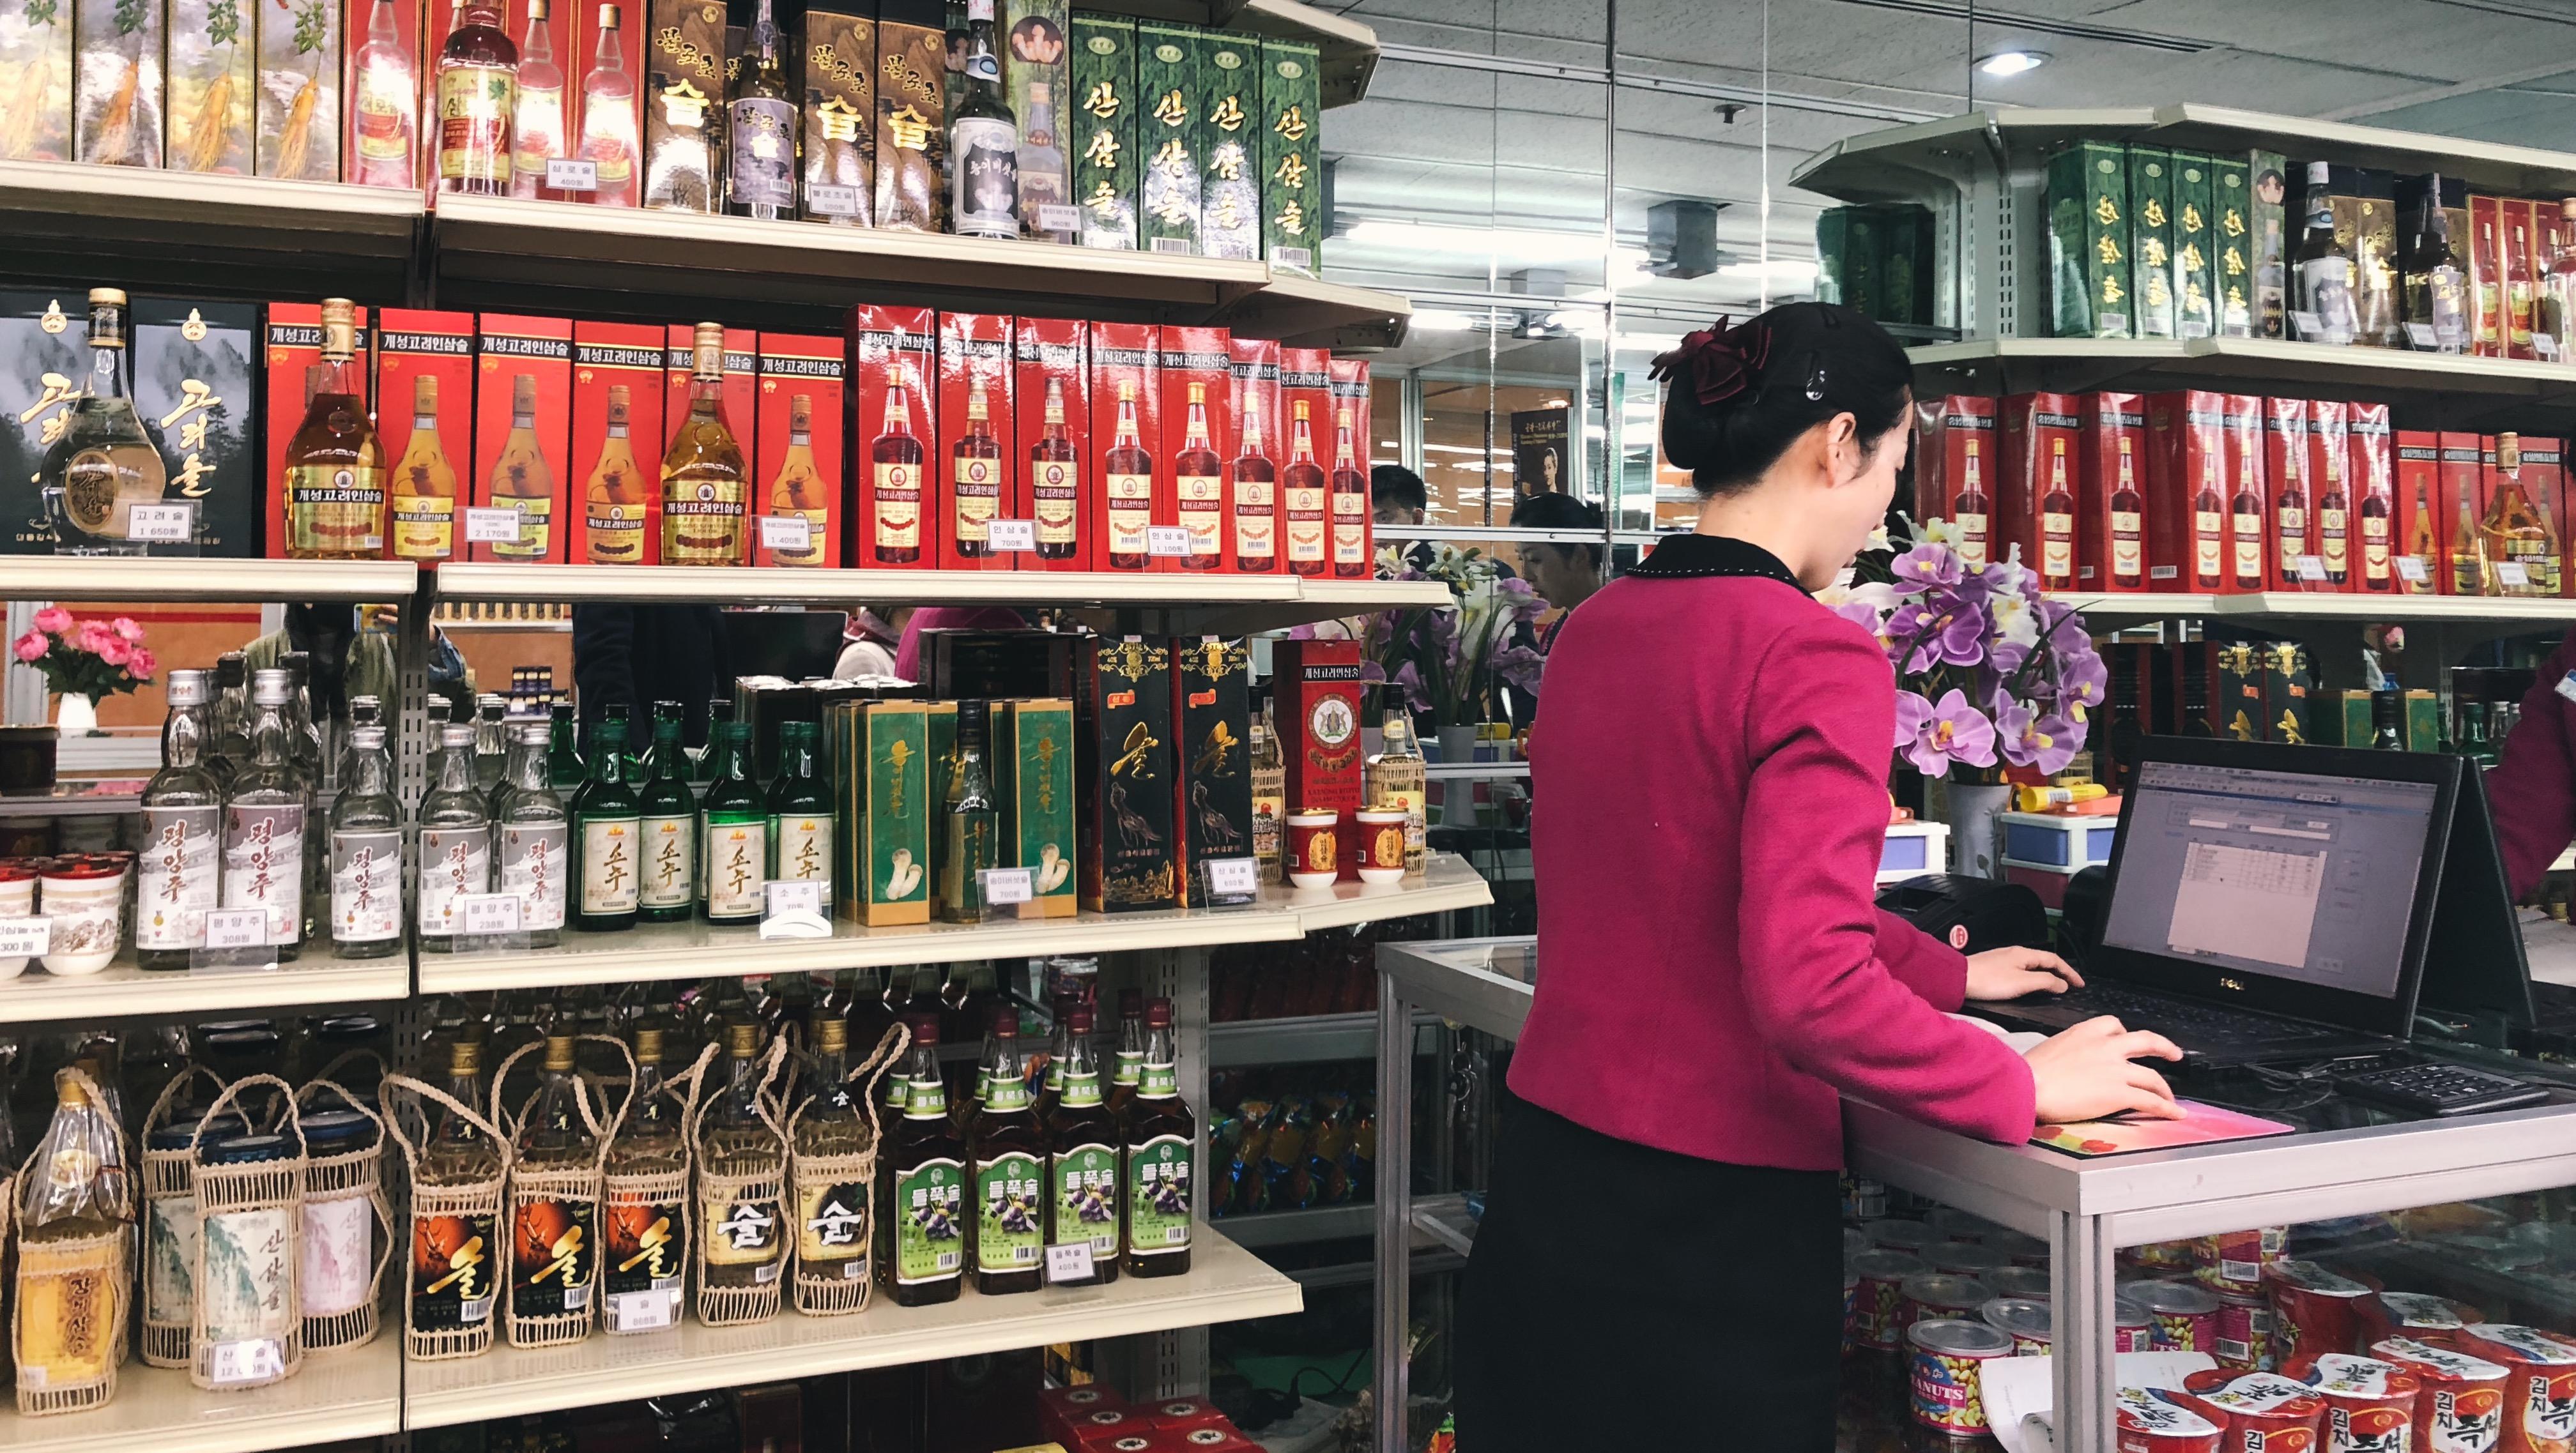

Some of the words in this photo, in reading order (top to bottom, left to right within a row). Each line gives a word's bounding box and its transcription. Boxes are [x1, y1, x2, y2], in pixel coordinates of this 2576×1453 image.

[816, 95, 862, 141] 술
[888, 104, 932, 150] 술
[1084, 81, 1120, 218] 산삼술
[1153, 89, 1188, 225] 산삼술
[1209, 96, 1245, 231] 산삼술
[1275, 105, 1307, 235] 산삼술
[271, 327, 364, 346] 개성고술
[384, 334, 468, 353] 개성고려인삼술
[482, 337, 569, 356] 개성고려인삼술
[578, 348, 662, 366] 개성고려인삼술
[671, 352, 753, 370] 개성삼술
[762, 358, 841, 376] 개성고려인삼술
[1231, 363, 1280, 379] 성고려인삼술
[1282, 373, 1330, 388] 성고려인삼술
[993, 526, 1028, 534] 인삼술
[1152, 532, 1184, 540] 인삼술
[160, 818, 188, 904] 평양주
[247, 816, 275, 901] 평양주
[529, 837, 549, 902] 평양주
[604, 841, 628, 892] 소주
[656, 837, 681, 888] 소주
[726, 846, 752, 894] 소주
[795, 836, 820, 879] 소주
[353, 845, 374, 911] 평양주
[2220, 978, 2244, 991] DELL
[222, 1347, 266, 1362] 산술
[1912, 1374, 1964, 1401] ANUTS
[2331, 1408, 2350, 1447] 김치
[2435, 1392, 2455, 1430] 김치
